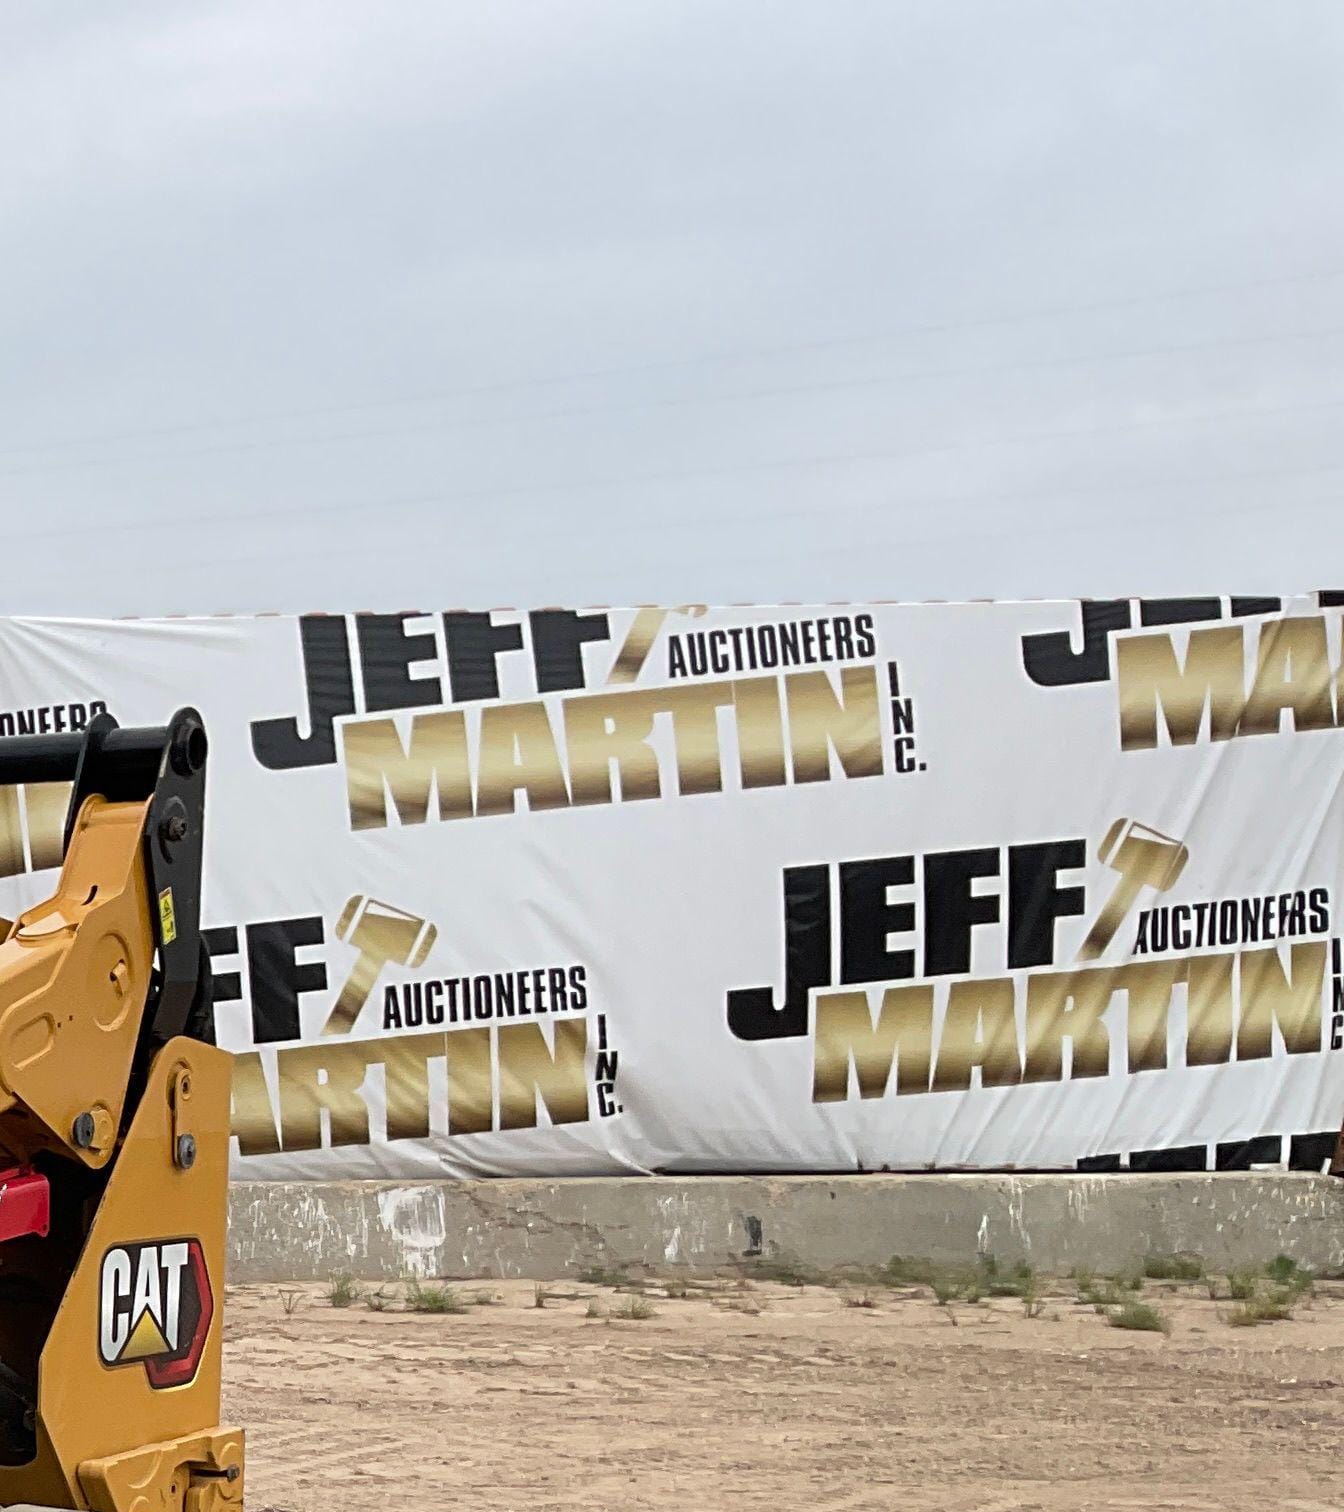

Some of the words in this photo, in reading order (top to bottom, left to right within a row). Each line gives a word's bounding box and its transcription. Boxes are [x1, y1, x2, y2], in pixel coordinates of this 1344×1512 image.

[250, 611, 611, 770] JEFF
[668, 614, 876, 678] AUCTIONEERS
[1116, 615, 1344, 752] MA
[343, 664, 885, 832] MARTIN
[887, 661, 927, 774] INC.
[726, 839, 1087, 1041] JEFF
[1132, 888, 1329, 955] AUCTIONEERS
[383, 966, 587, 1030] AUCTIONEERS
[812, 940, 1328, 1103] MARTIN
[595, 1013, 624, 1118] INC.
[101, 1243, 189, 1362] CAT
